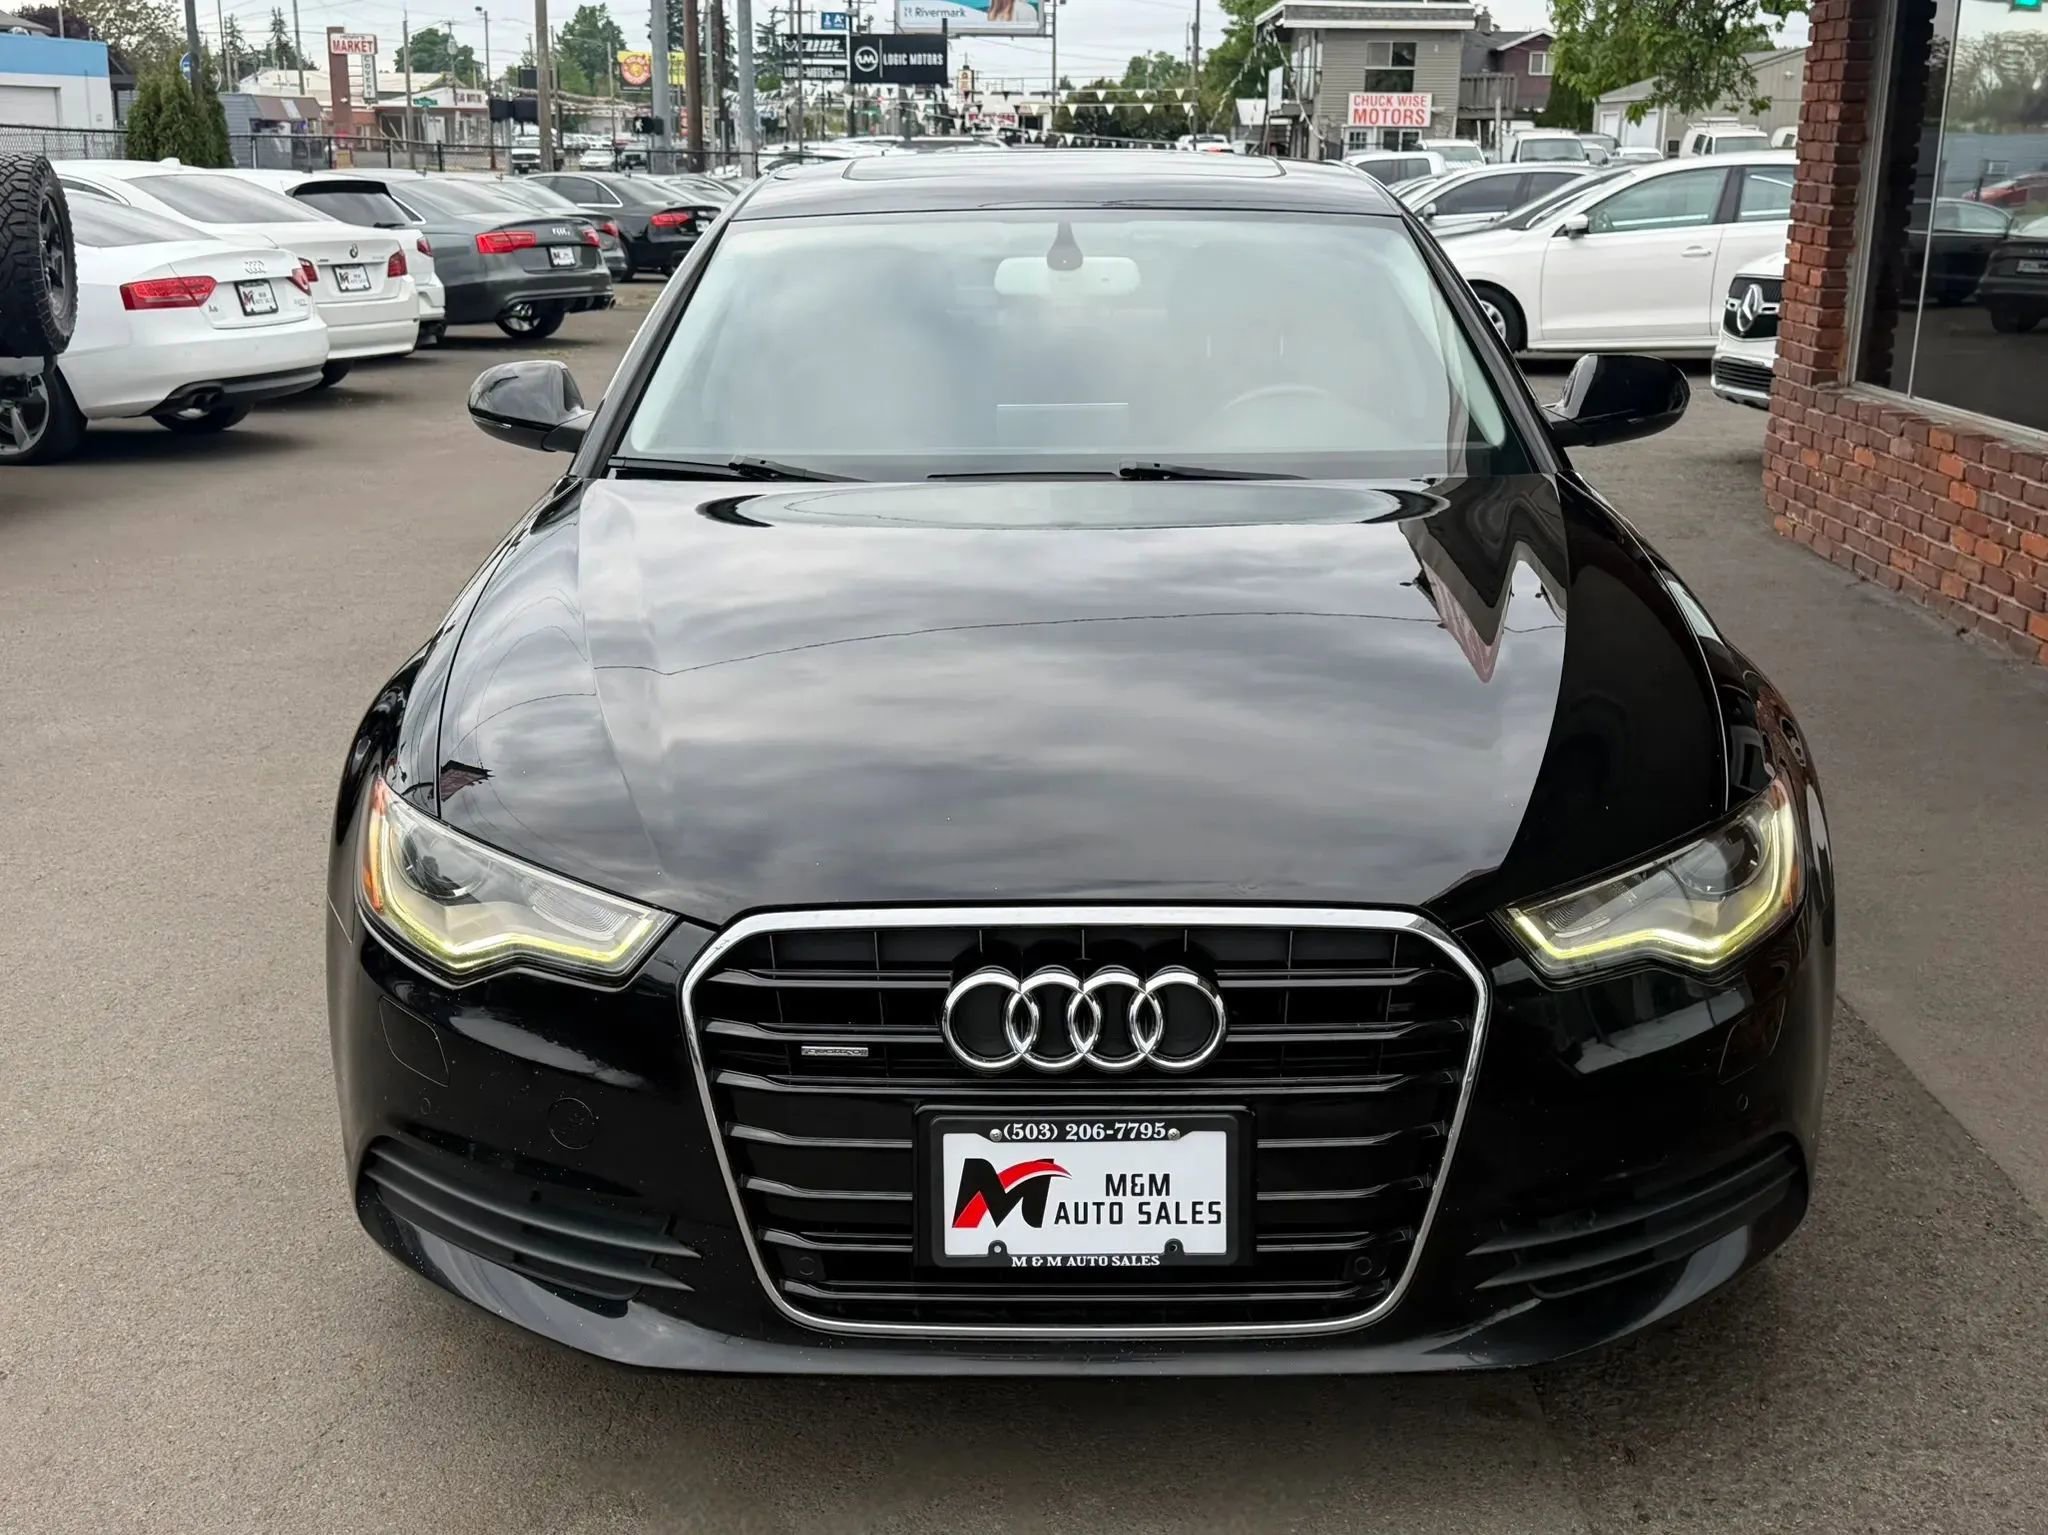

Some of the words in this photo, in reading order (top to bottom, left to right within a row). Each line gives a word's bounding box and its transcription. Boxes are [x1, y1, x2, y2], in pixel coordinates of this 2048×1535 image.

[915, 7, 966, 17] Rivermark
[332, 39, 373, 53] MARKET
[883, 53, 908, 66] LOGIC
[909, 53, 944, 66] MOTORS
[1354, 95, 1393, 107] CHUCK
[1397, 95, 1427, 107] WISE
[1353, 108, 1425, 125] MOTORS
[1003, 1123, 1058, 1140] (503)
[1065, 1122, 1166, 1140] 206-7795
[1105, 1173, 1171, 1197] M&M
[1054, 1201, 1124, 1225] AUTO
[1137, 1201, 1222, 1225] SALES
[1011, 1256, 1028, 1267] M
[1032, 1256, 1043, 1267] &
[1046, 1256, 1062, 1267] M
[1066, 1256, 1108, 1267] AUTO
[1111, 1255, 1161, 1267] SALES
